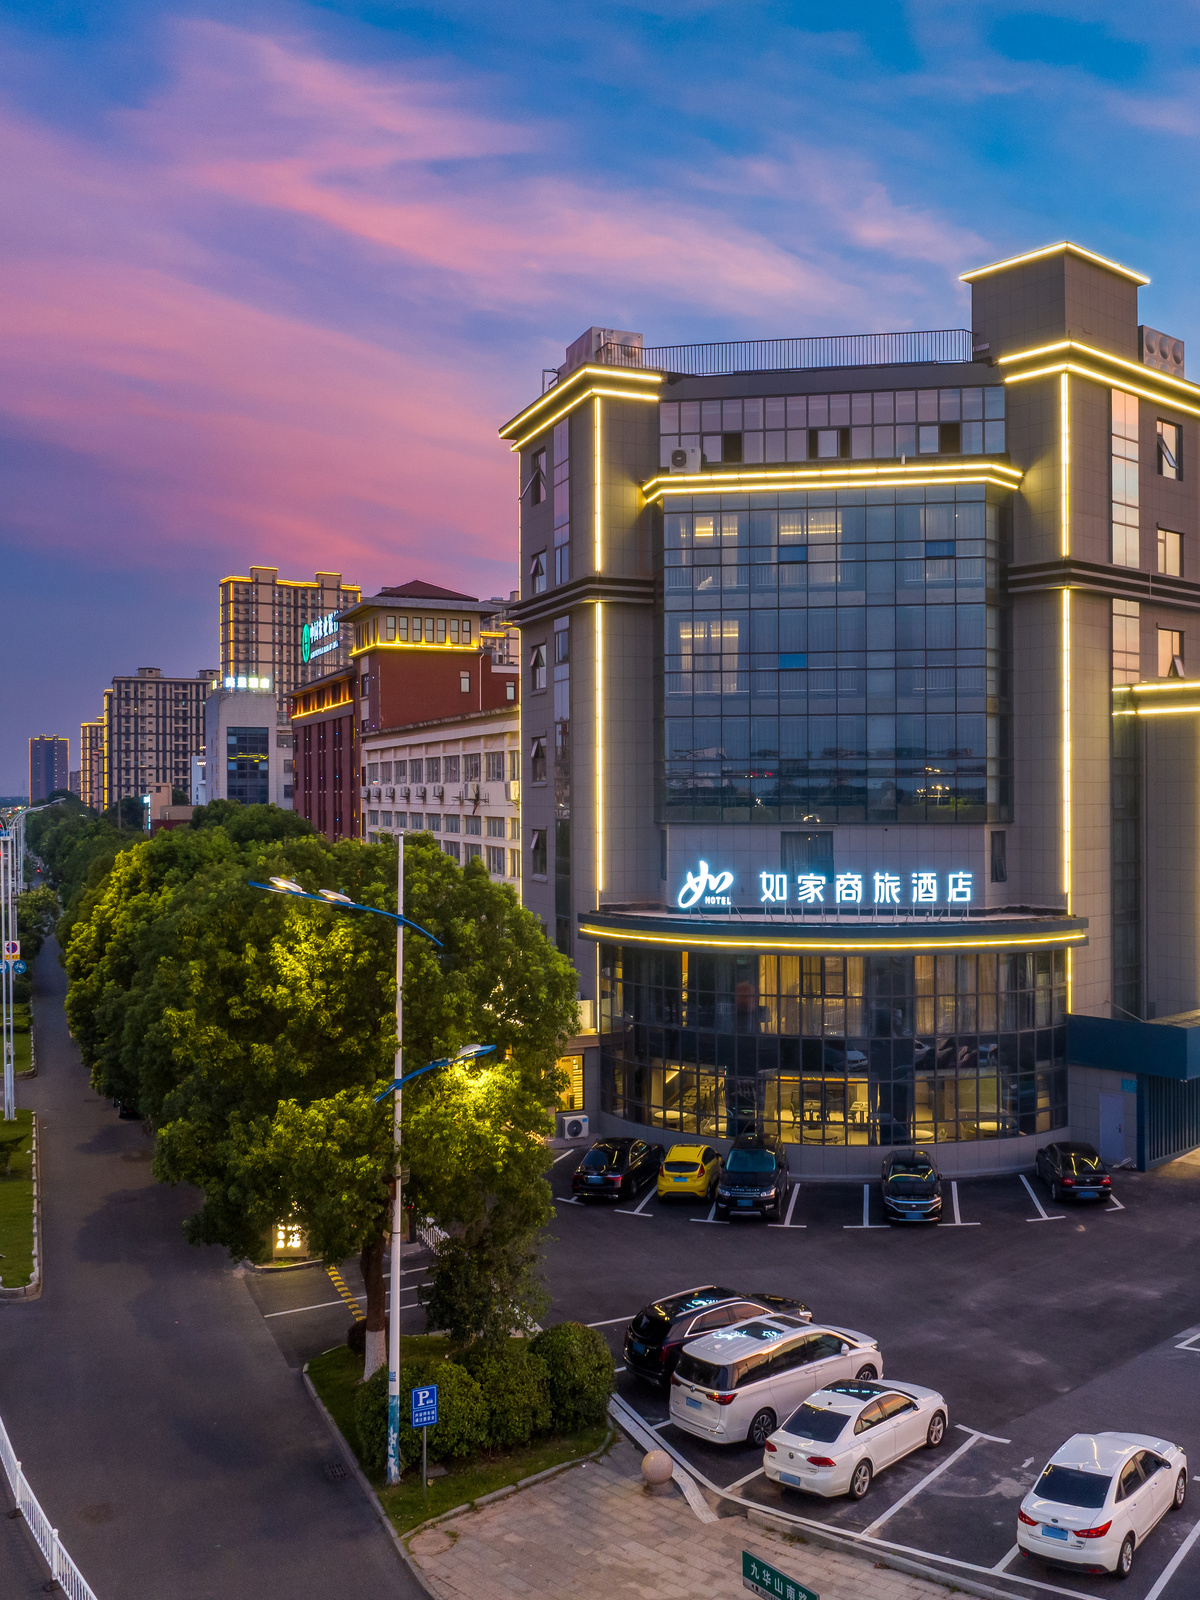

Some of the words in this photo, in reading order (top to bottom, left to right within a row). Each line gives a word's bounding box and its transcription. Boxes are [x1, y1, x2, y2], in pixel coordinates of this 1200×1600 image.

[759, 871, 973, 904] 如家商旅酒店
[704, 895, 732, 906] HOTEL
[417, 1390, 429, 1406] P
